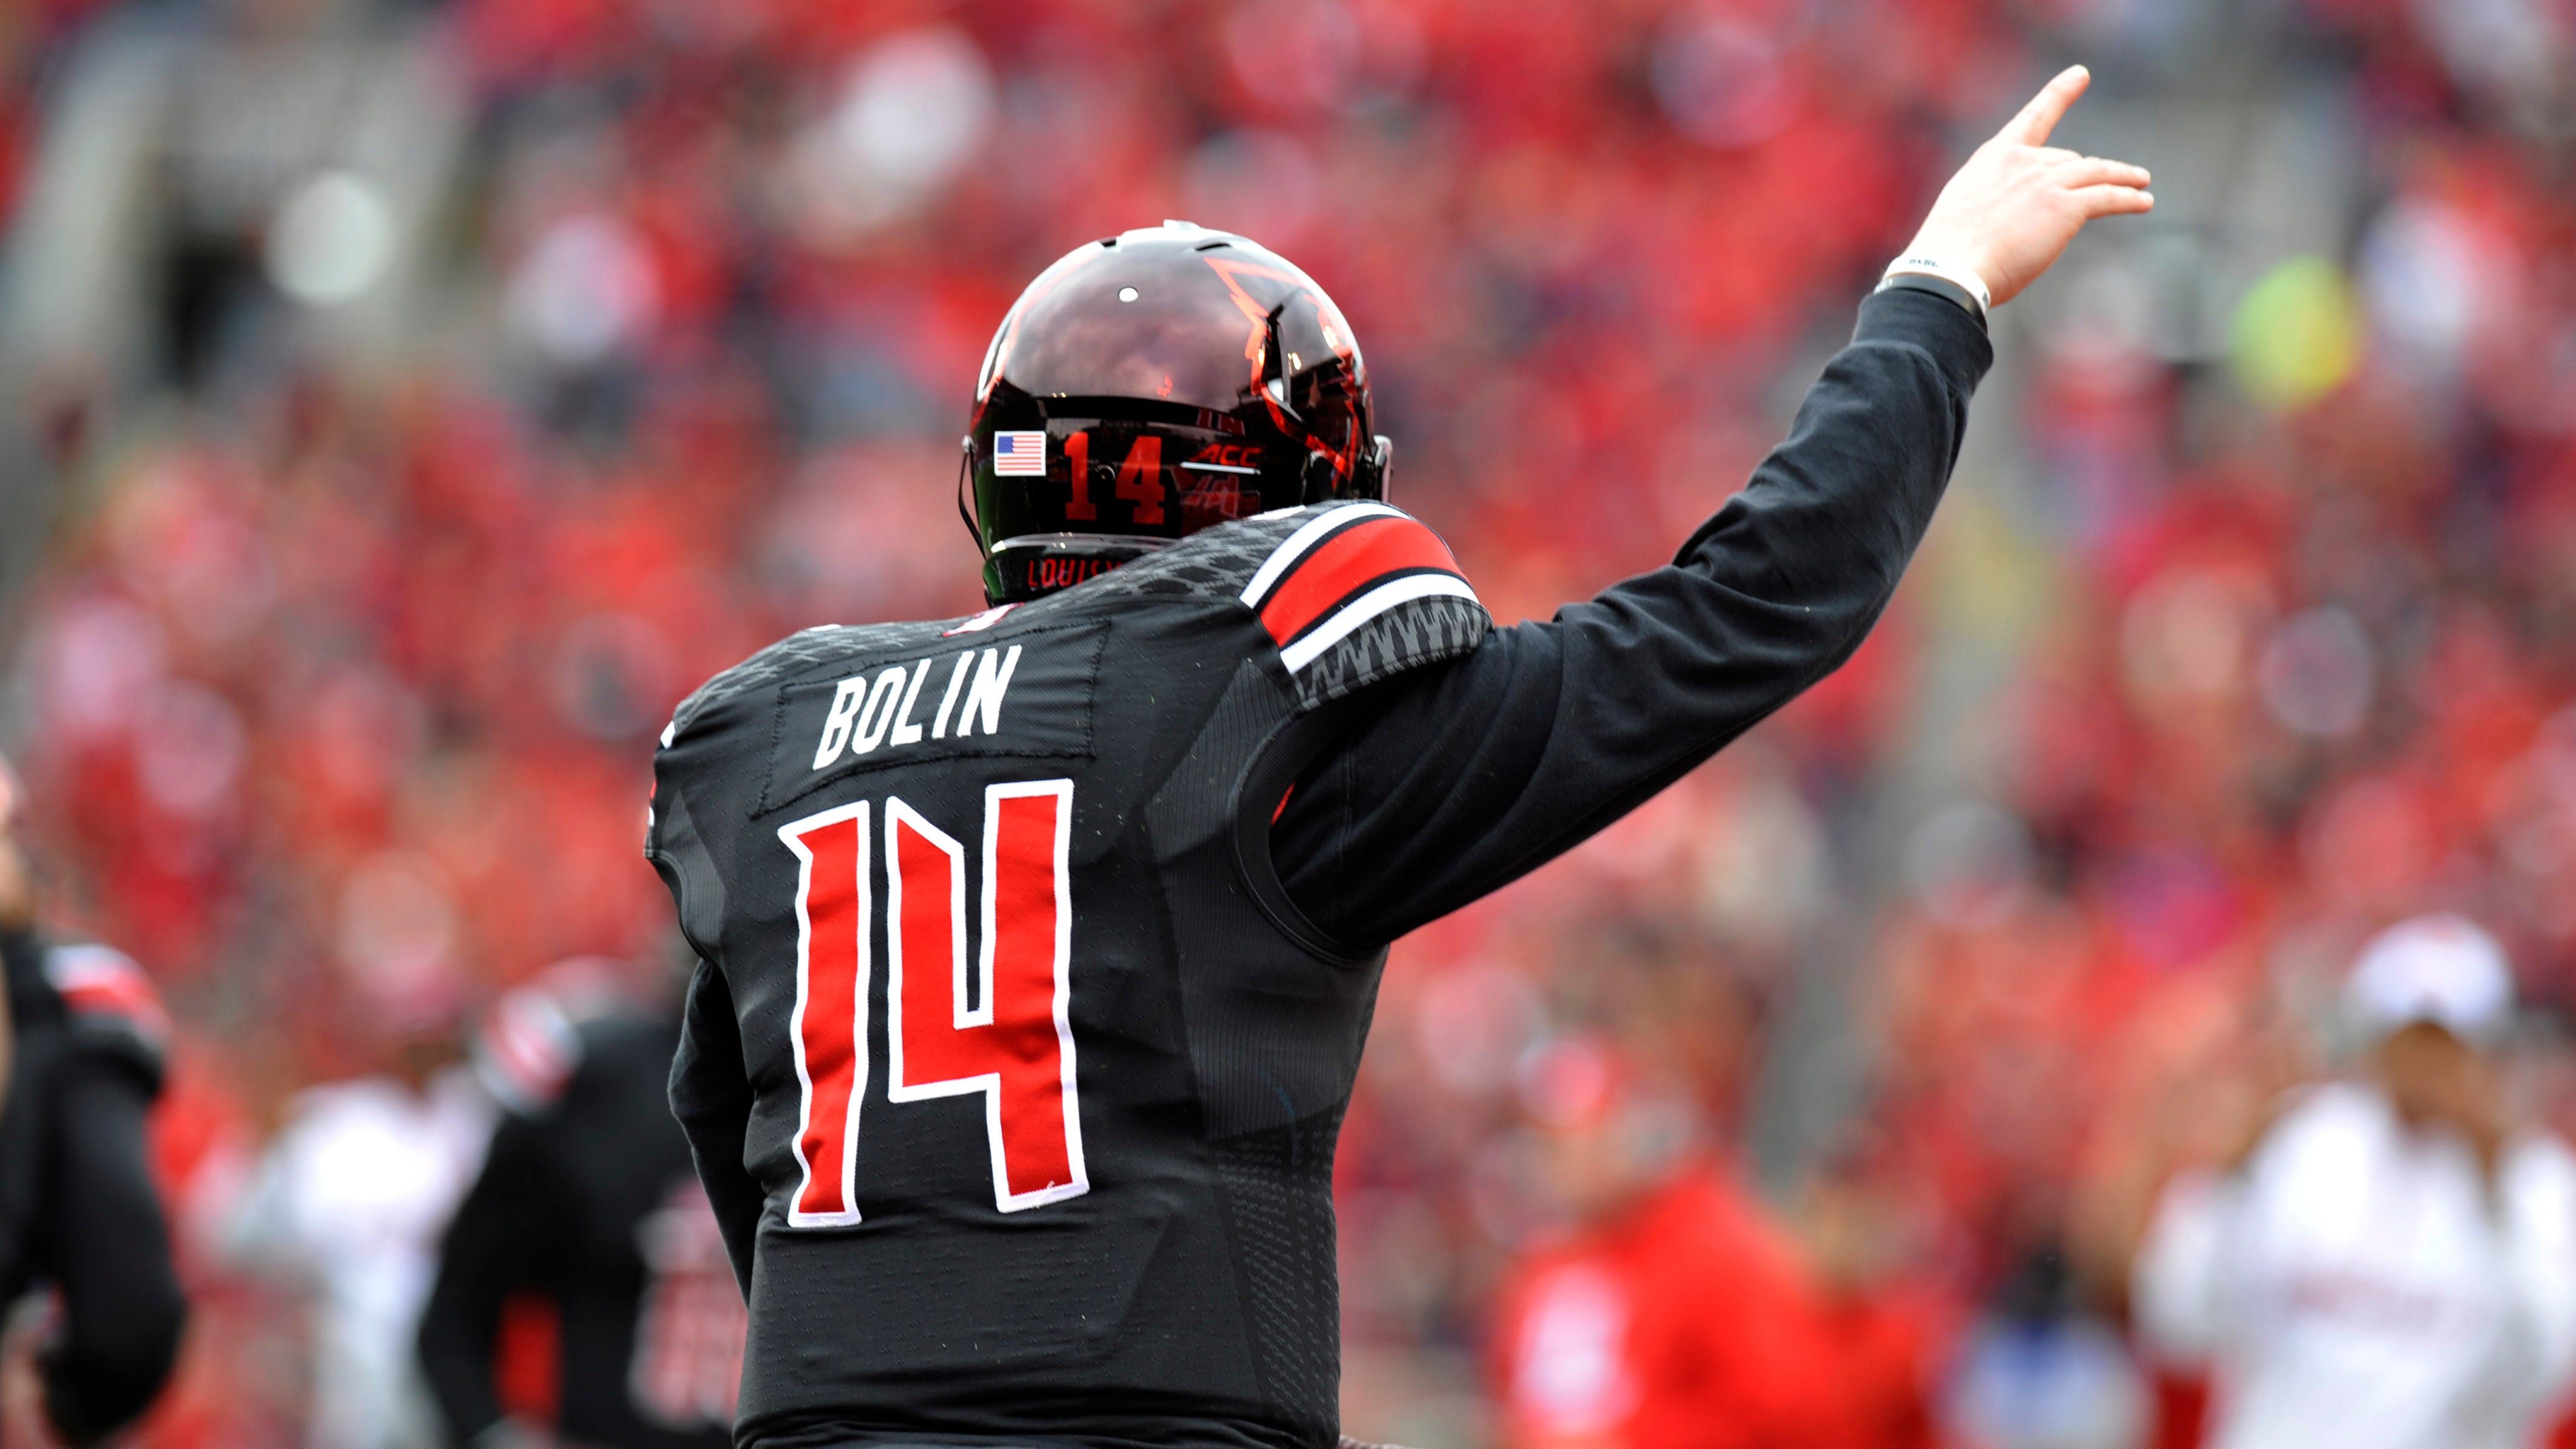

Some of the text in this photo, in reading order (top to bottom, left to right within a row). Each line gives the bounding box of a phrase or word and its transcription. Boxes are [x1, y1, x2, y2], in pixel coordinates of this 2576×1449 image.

[1064, 432, 1165, 525] 14
[1189, 443, 1263, 468] ACC
[813, 645, 1022, 770] BOLIN
[778, 778, 1089, 1227] 14
